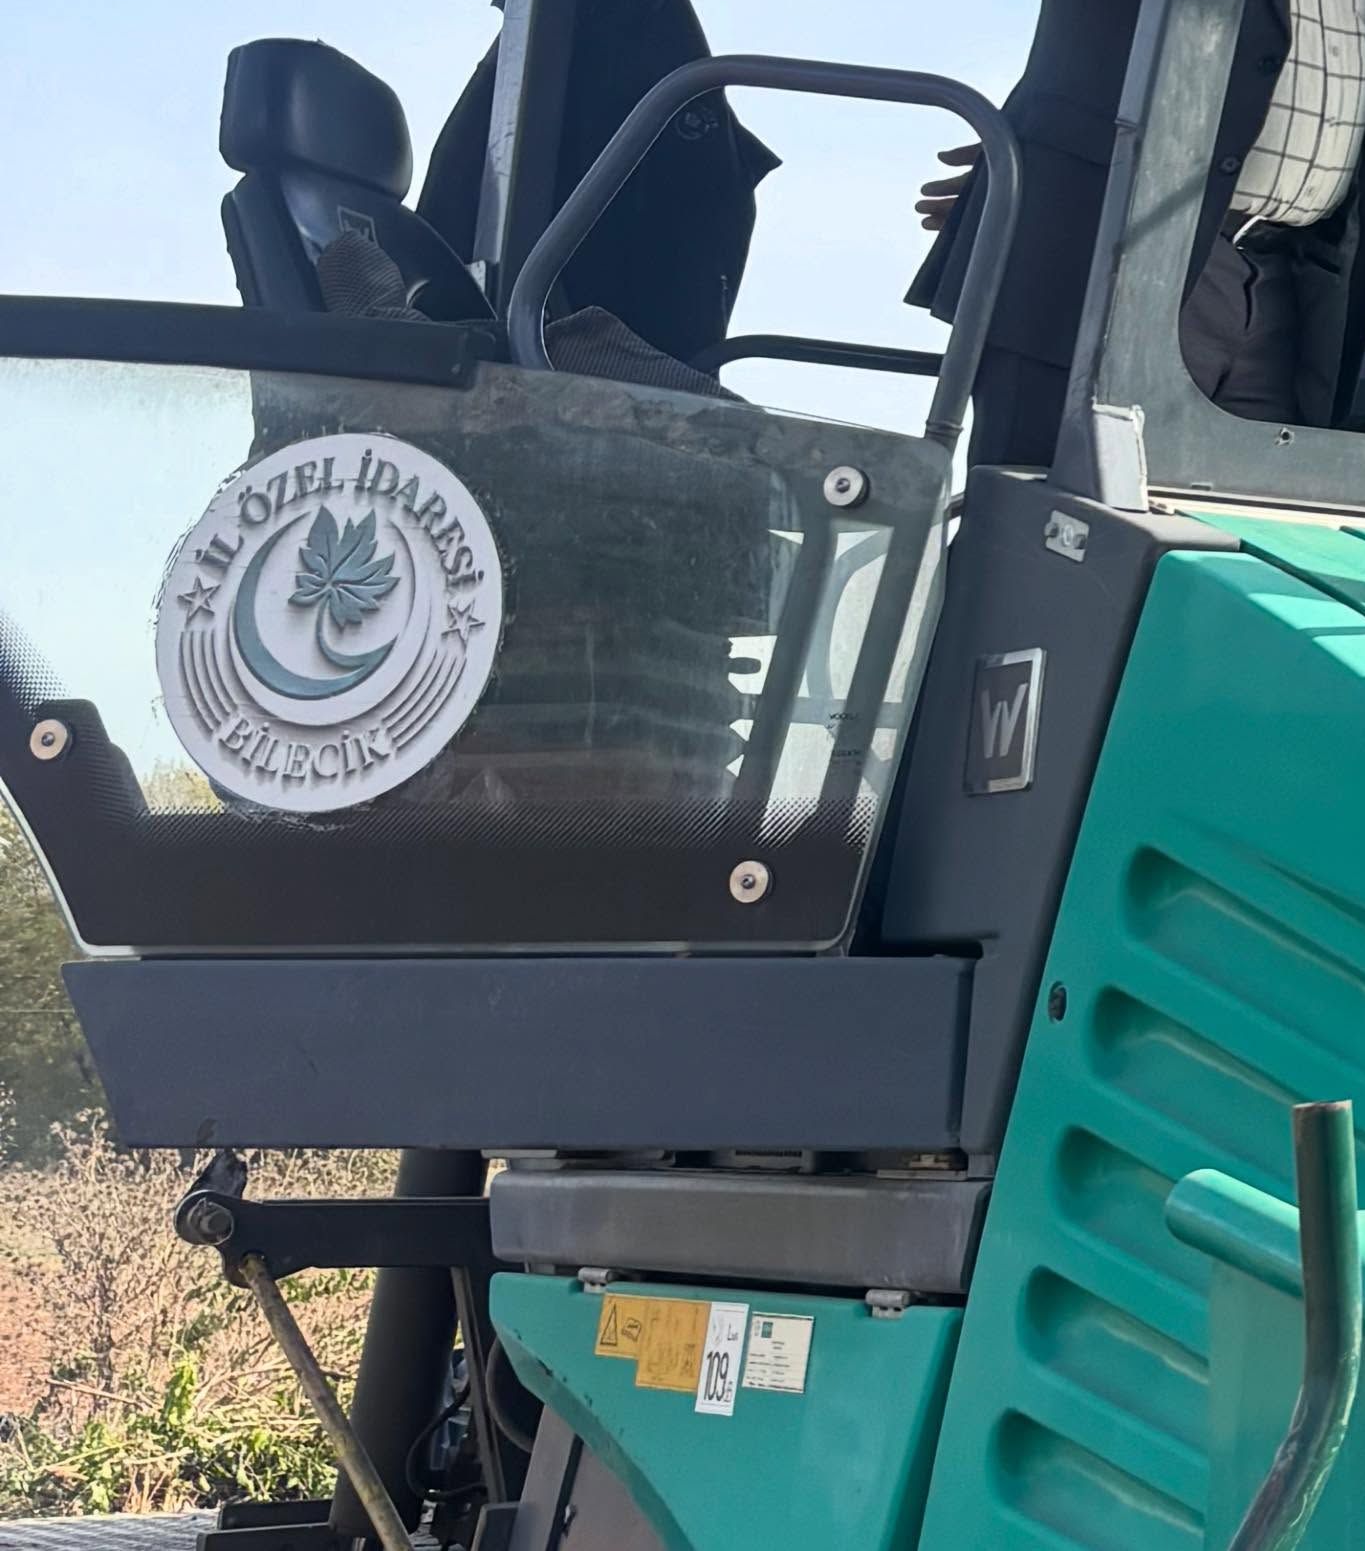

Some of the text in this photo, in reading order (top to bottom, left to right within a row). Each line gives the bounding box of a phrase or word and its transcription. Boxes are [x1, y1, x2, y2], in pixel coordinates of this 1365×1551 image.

[197, 448, 485, 588] İL ÖZEL İDARESİ
[219, 717, 389, 780] BİLECİK
[980, 682, 1029, 759] W
[704, 1351, 730, 1401] 109
